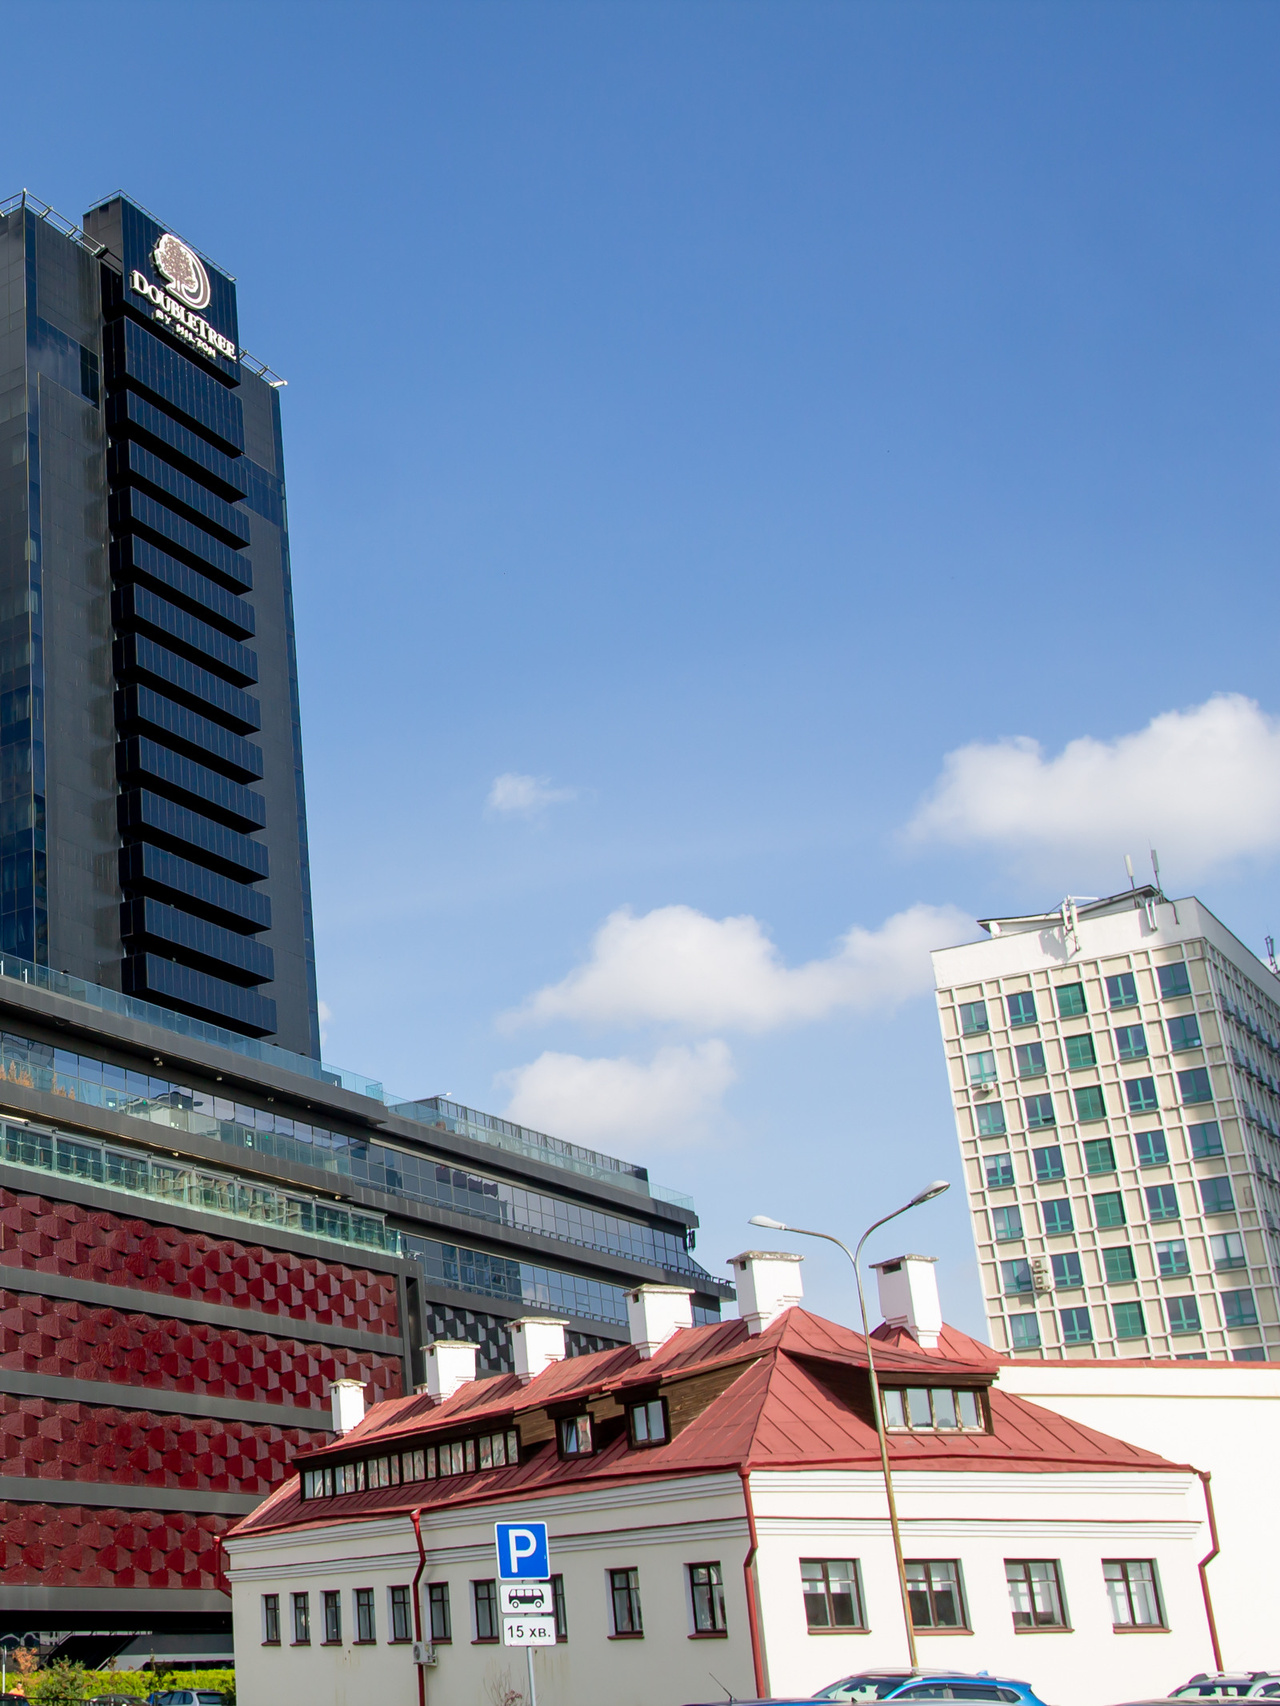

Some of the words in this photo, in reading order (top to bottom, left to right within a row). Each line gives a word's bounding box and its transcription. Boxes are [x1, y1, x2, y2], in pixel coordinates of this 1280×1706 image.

[155, 309, 172, 325] BY
[176, 324, 216, 359] HILTON
[508, 1529, 537, 1573] P
[507, 1625, 524, 1638] 15
